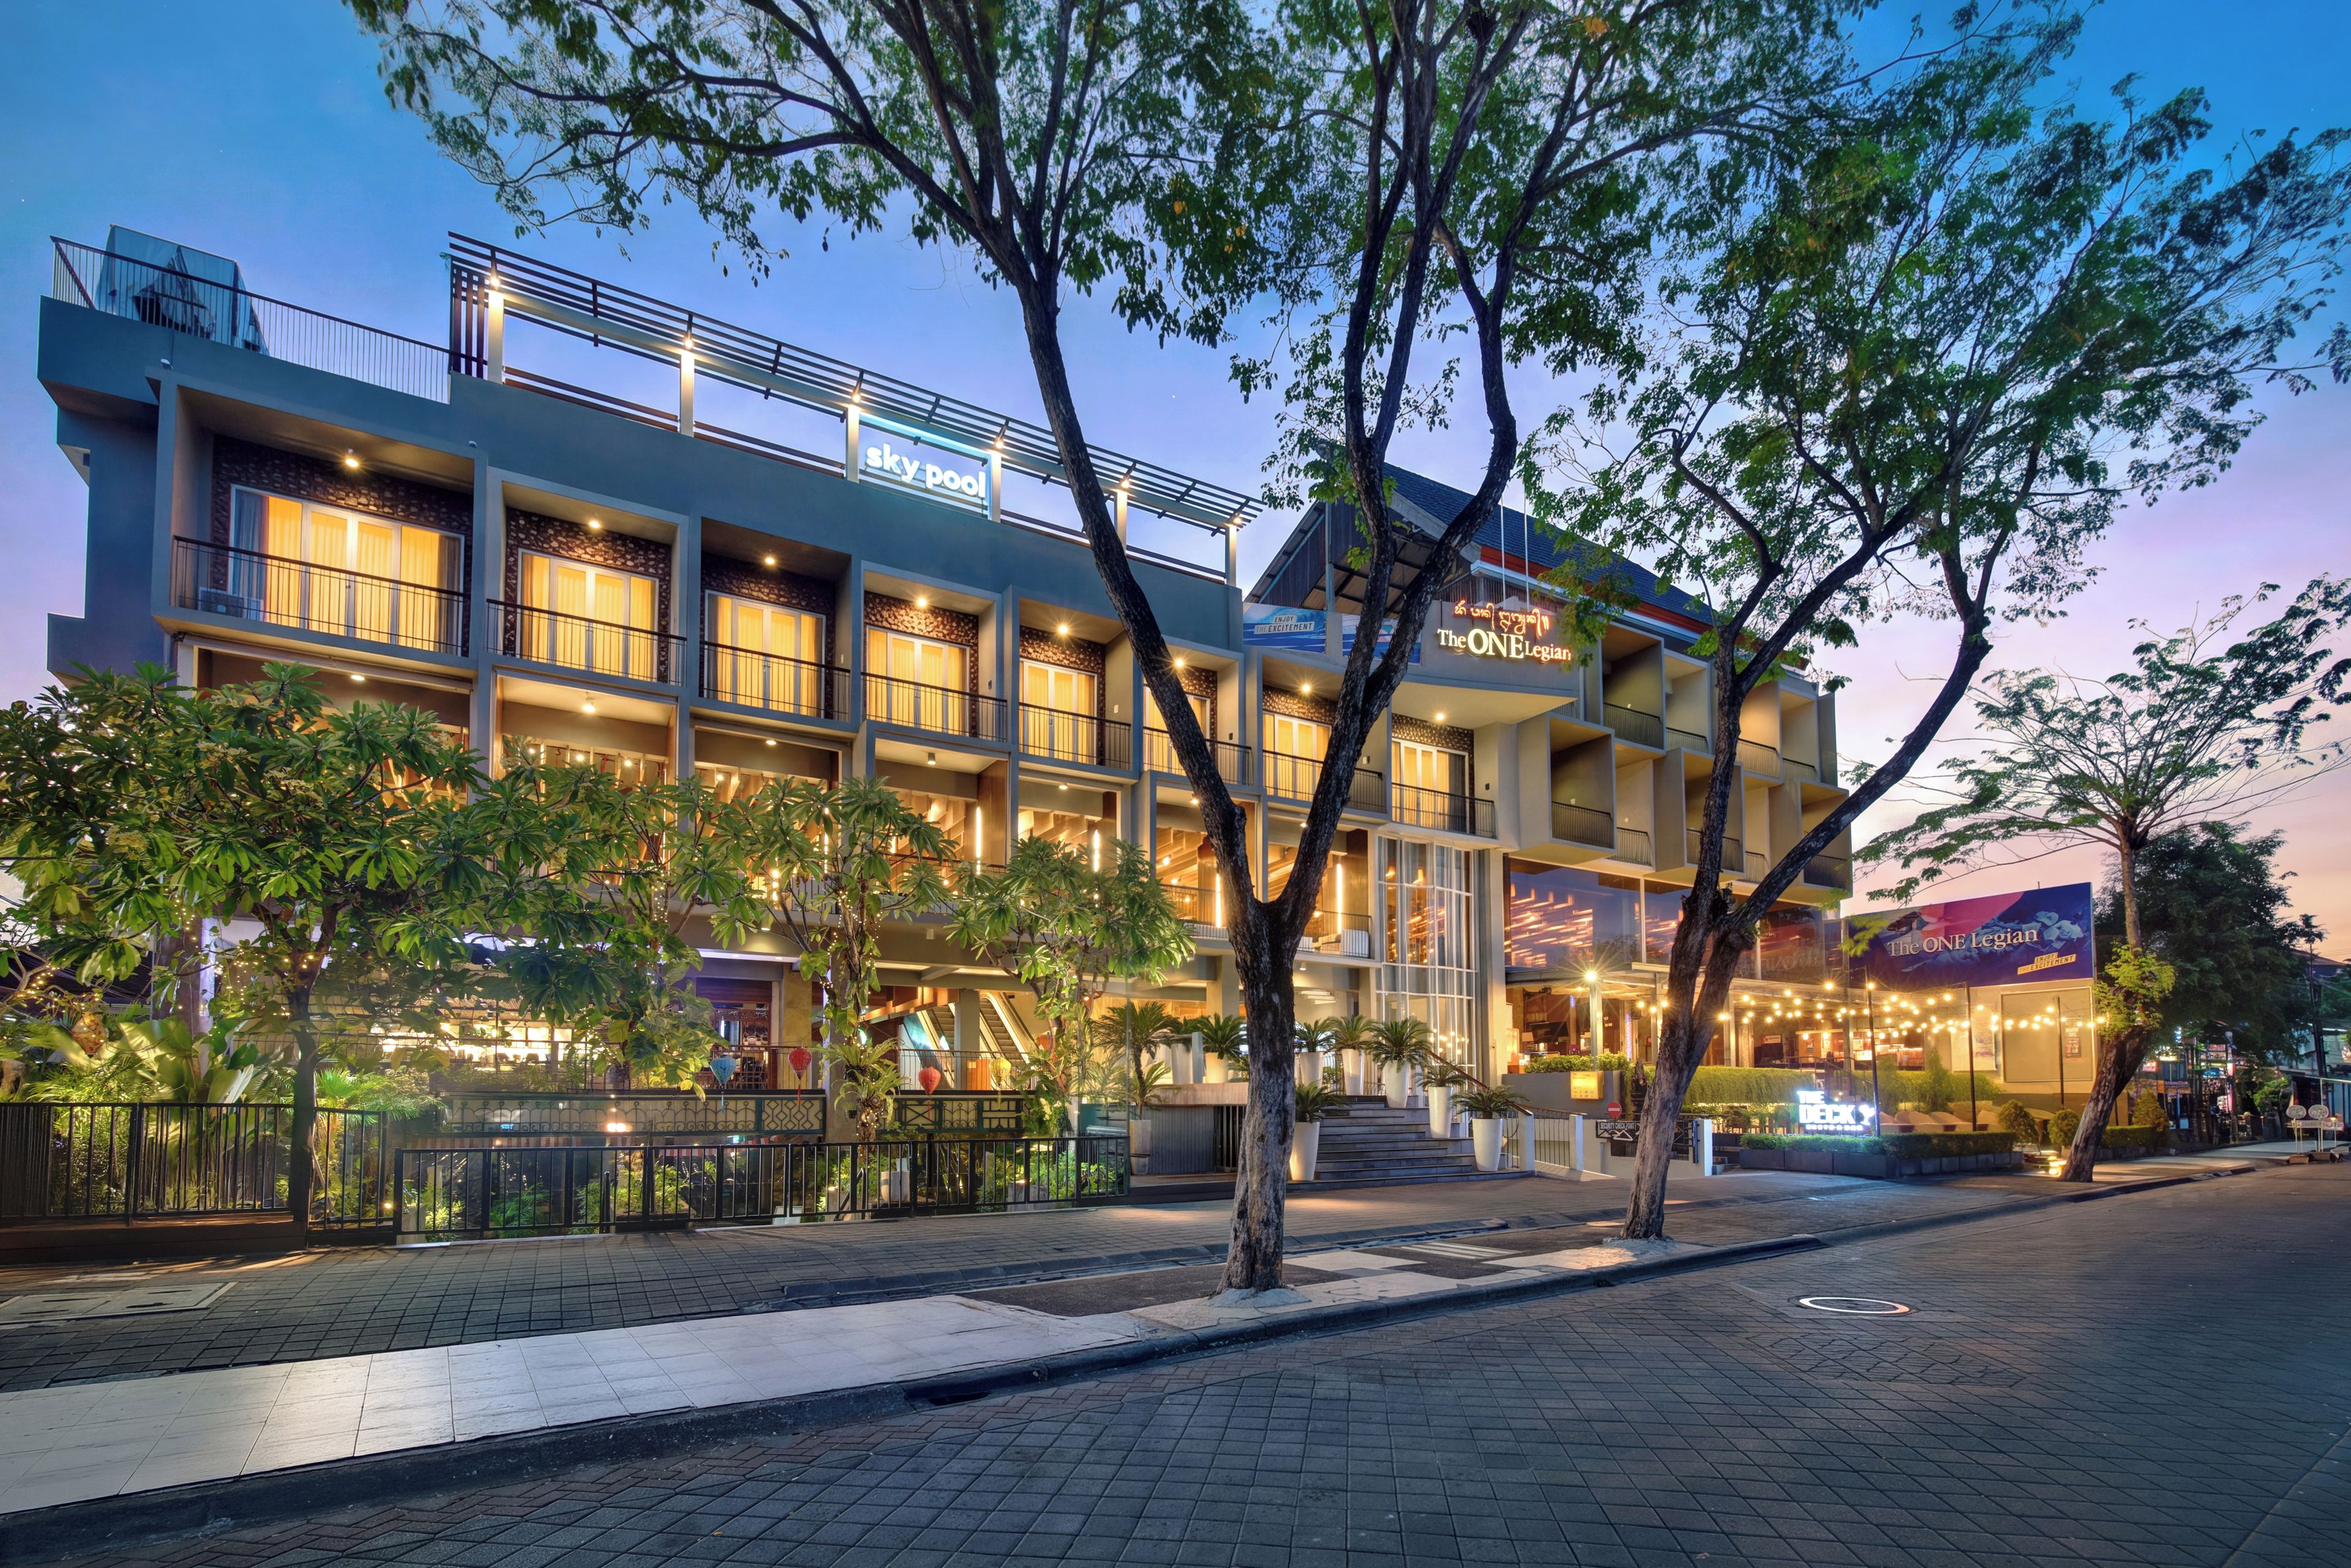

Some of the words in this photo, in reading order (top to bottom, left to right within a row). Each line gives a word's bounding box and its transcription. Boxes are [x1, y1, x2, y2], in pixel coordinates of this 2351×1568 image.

[866, 443, 920, 483] sky
[925, 463, 986, 498] pool
[1268, 623, 1313, 632] EXCITEMENT
[1437, 628, 1466, 648] The
[1467, 628, 1524, 659] ONE
[1887, 939, 1920, 957] The
[1922, 934, 1967, 953] ONE
[1971, 928, 2039, 950] Legian
[2030, 956, 2074, 971] EXCITEMENT
[2036, 953, 2055, 962] ENJOY
[1796, 1090, 1825, 1104] THE
[1799, 1104, 1856, 1124] DECK
